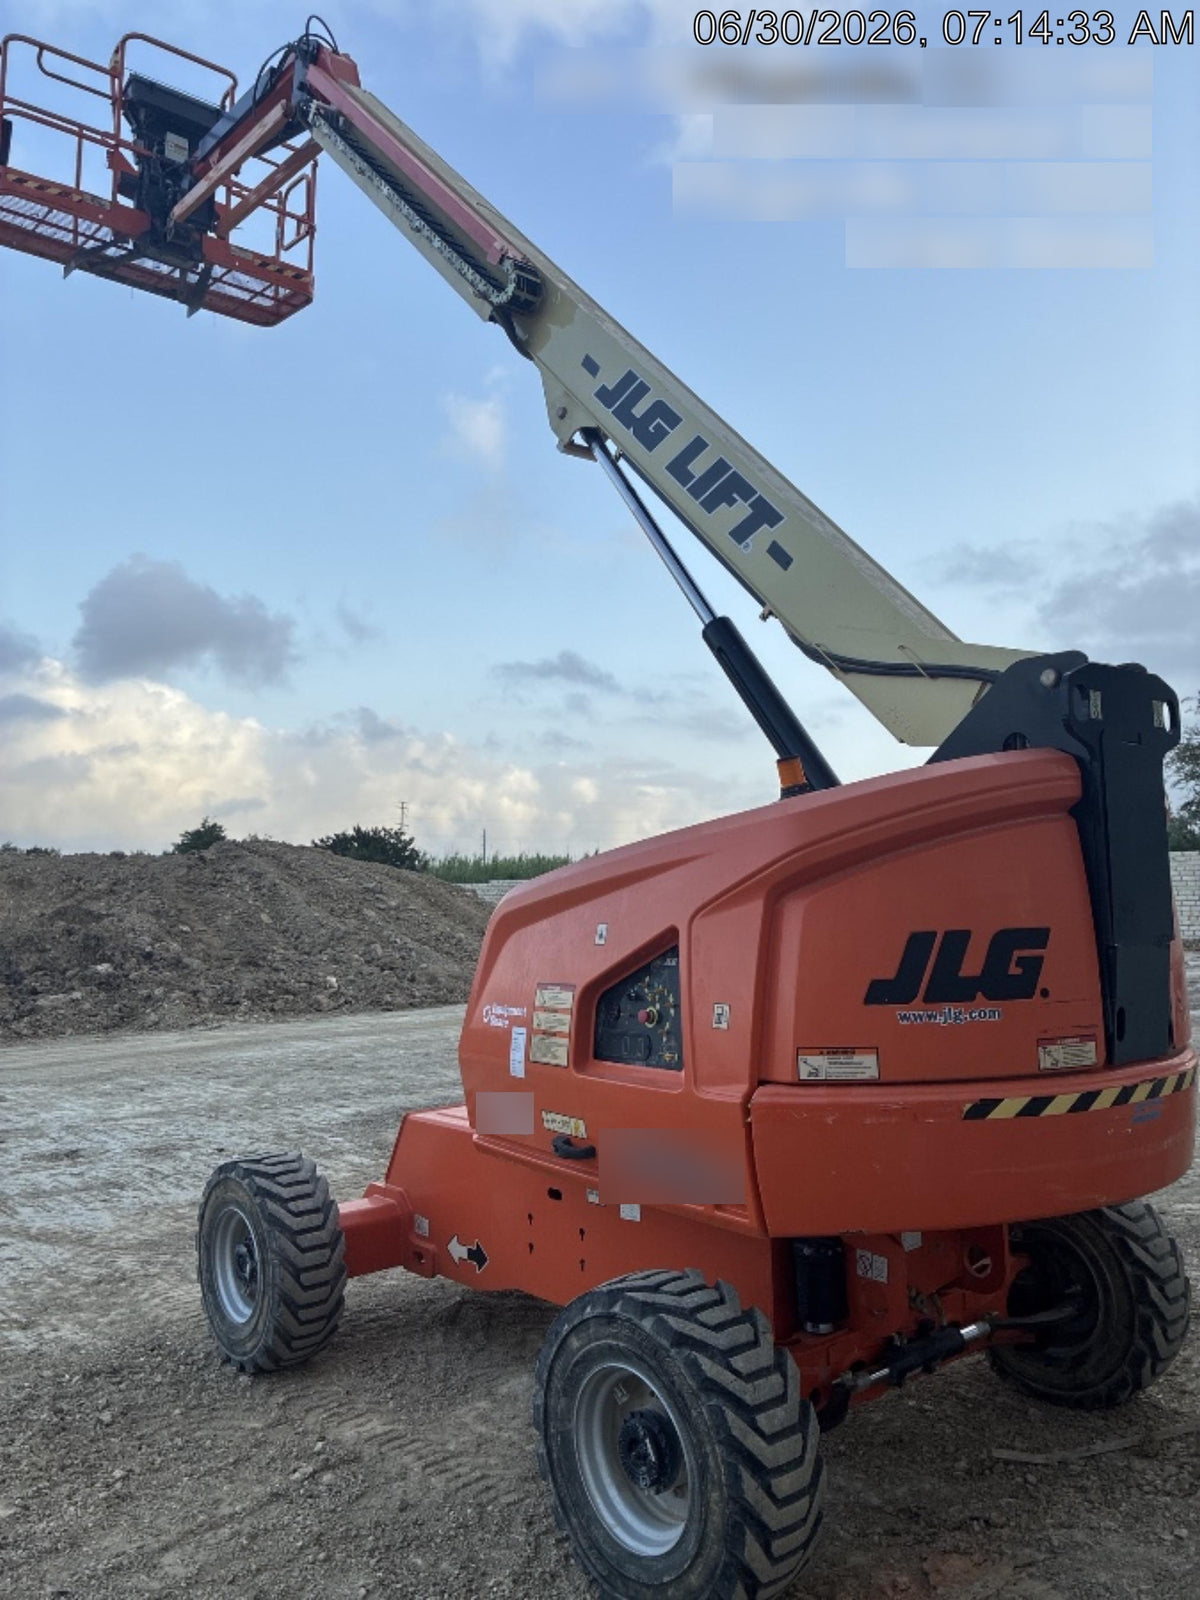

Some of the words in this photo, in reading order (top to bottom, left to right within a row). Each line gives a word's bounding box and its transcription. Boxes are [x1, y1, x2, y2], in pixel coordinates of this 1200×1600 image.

[593, 369, 683, 453] JLG
[664, 434, 786, 546] LIFT
[864, 927, 1051, 1005] JLG
[897, 1007, 1002, 1025] www.jlg.com
